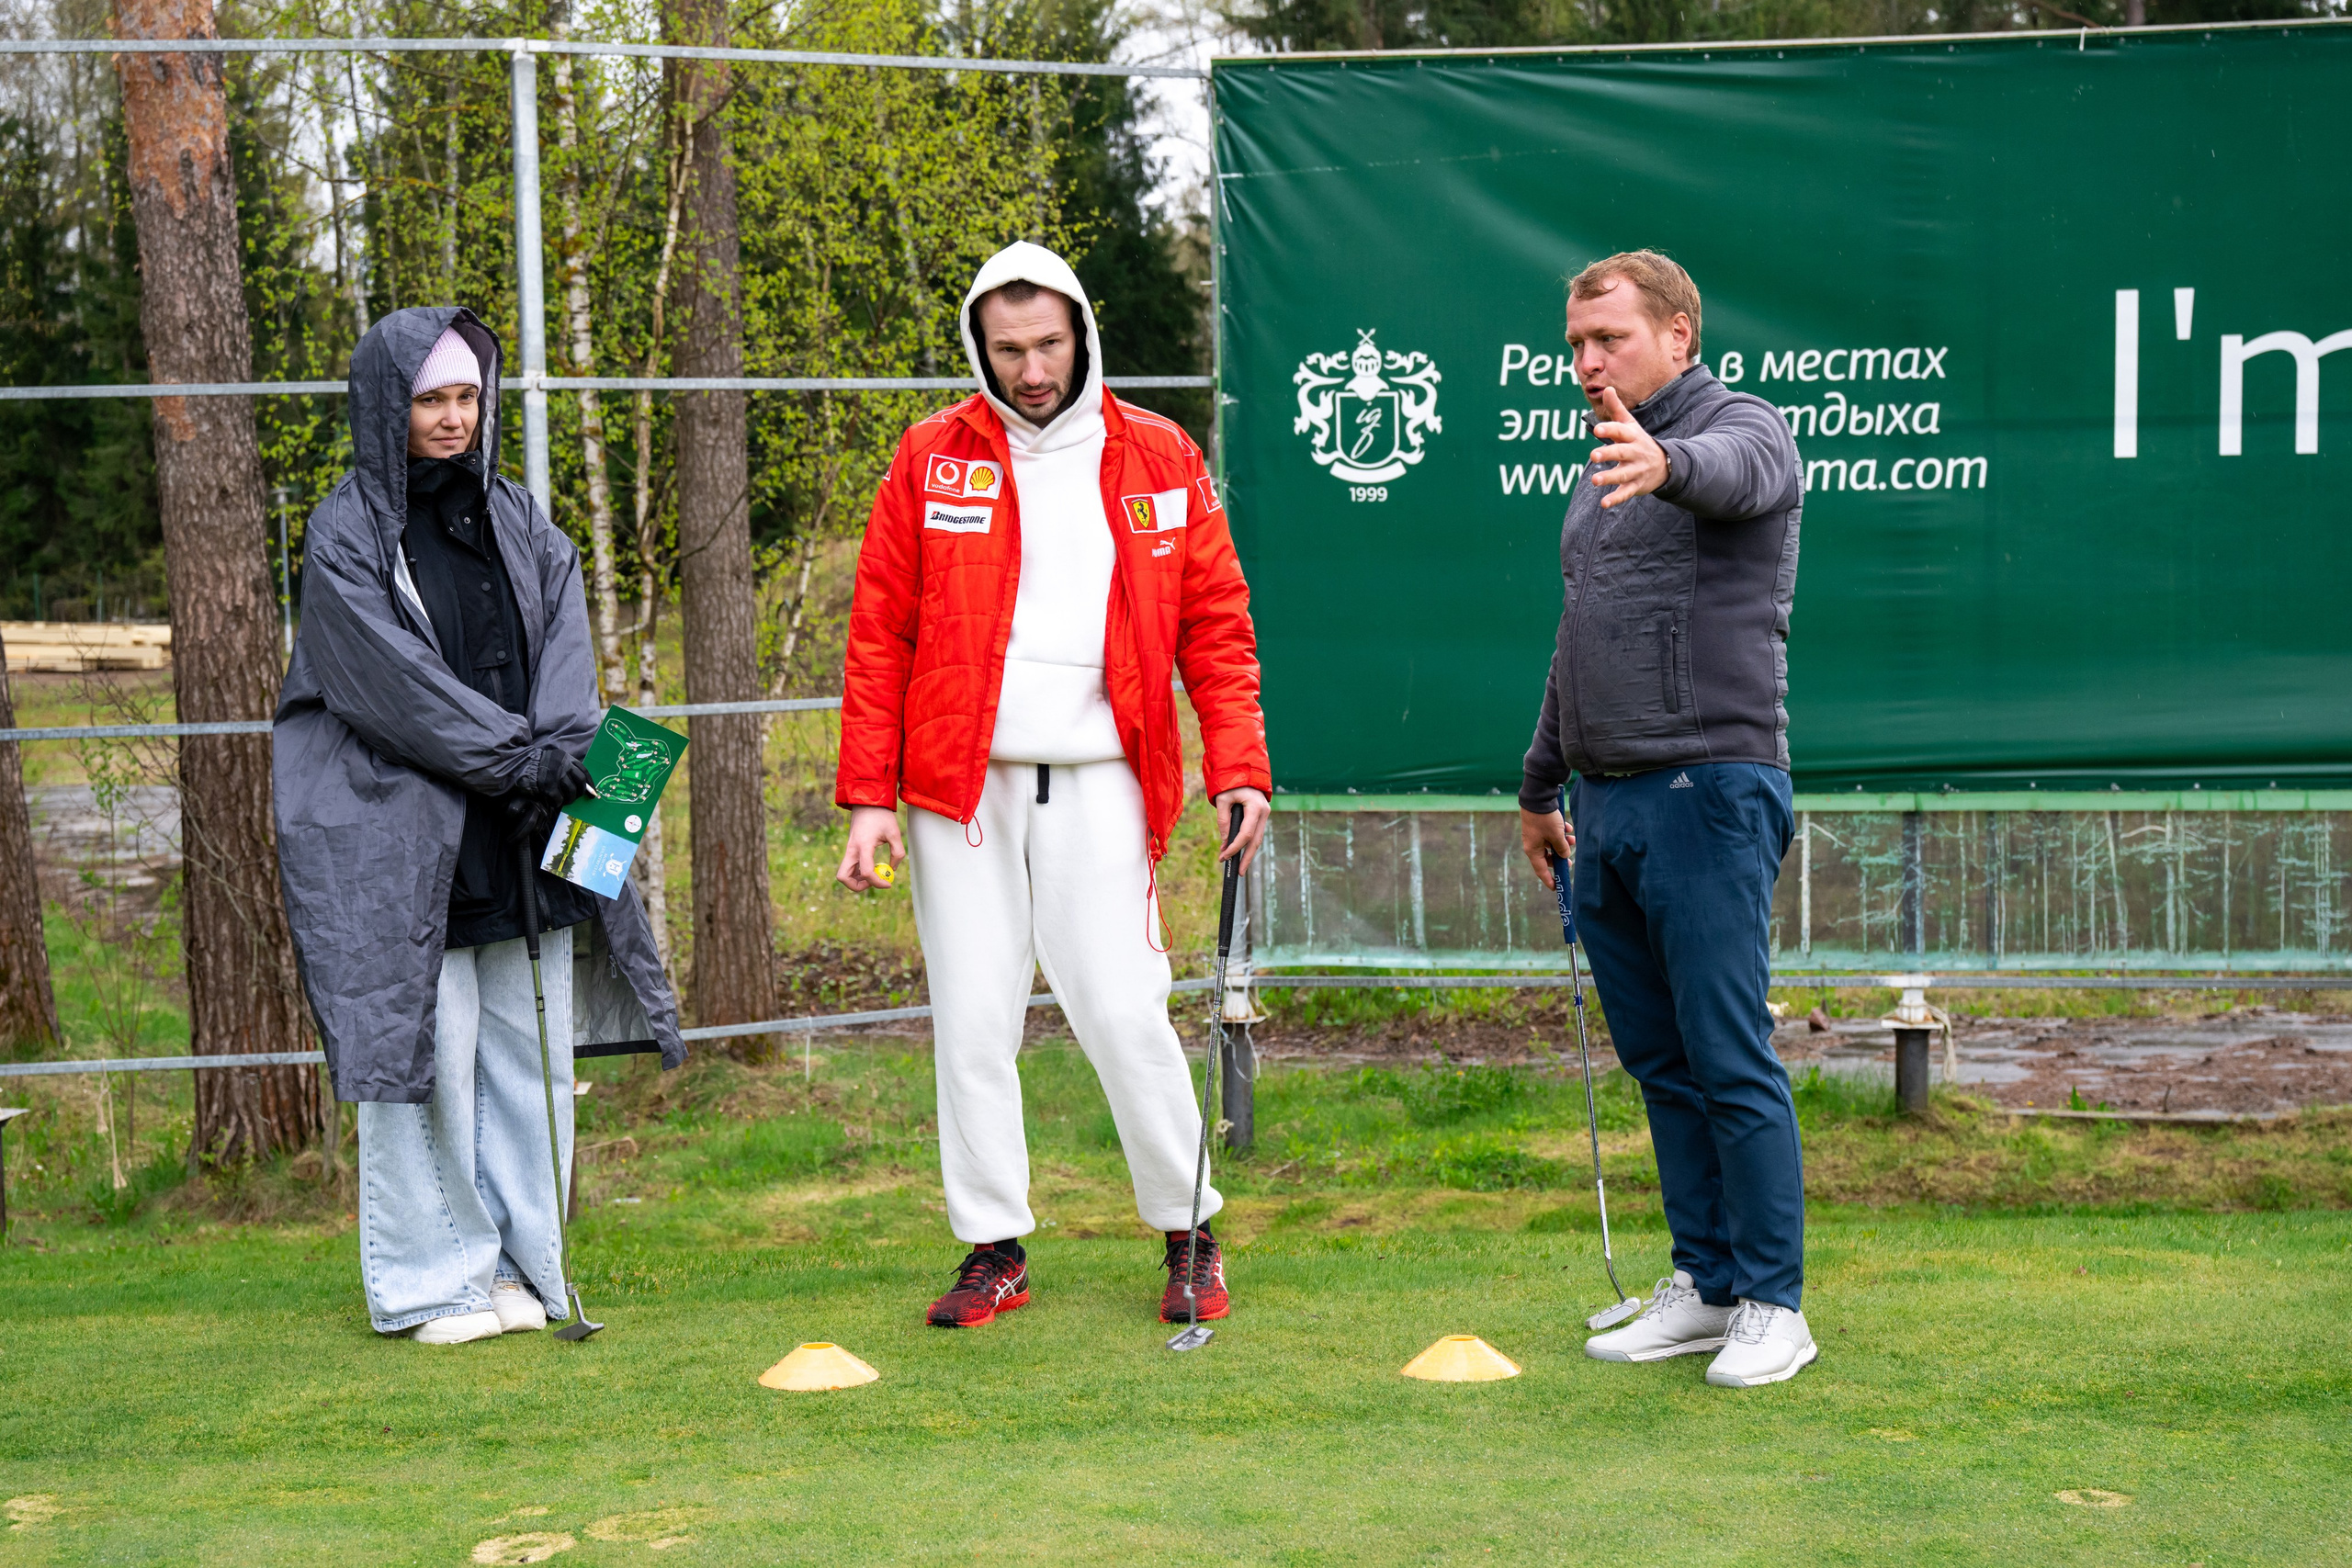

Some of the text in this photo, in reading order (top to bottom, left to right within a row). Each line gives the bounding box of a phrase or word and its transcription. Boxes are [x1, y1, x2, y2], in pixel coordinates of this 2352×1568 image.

[1499, 344, 1949, 387] Рек в местах
[2113, 287, 2352, 458] I'm
[1778, 391, 1940, 436] тдыха
[1804, 457, 1988, 491] ma.com
[931, 482, 961, 493] vodafone
[1349, 486, 1388, 502] 1999
[930, 510, 987, 525] BRIDGESTONE
[1668, 781, 1694, 789] adidas
